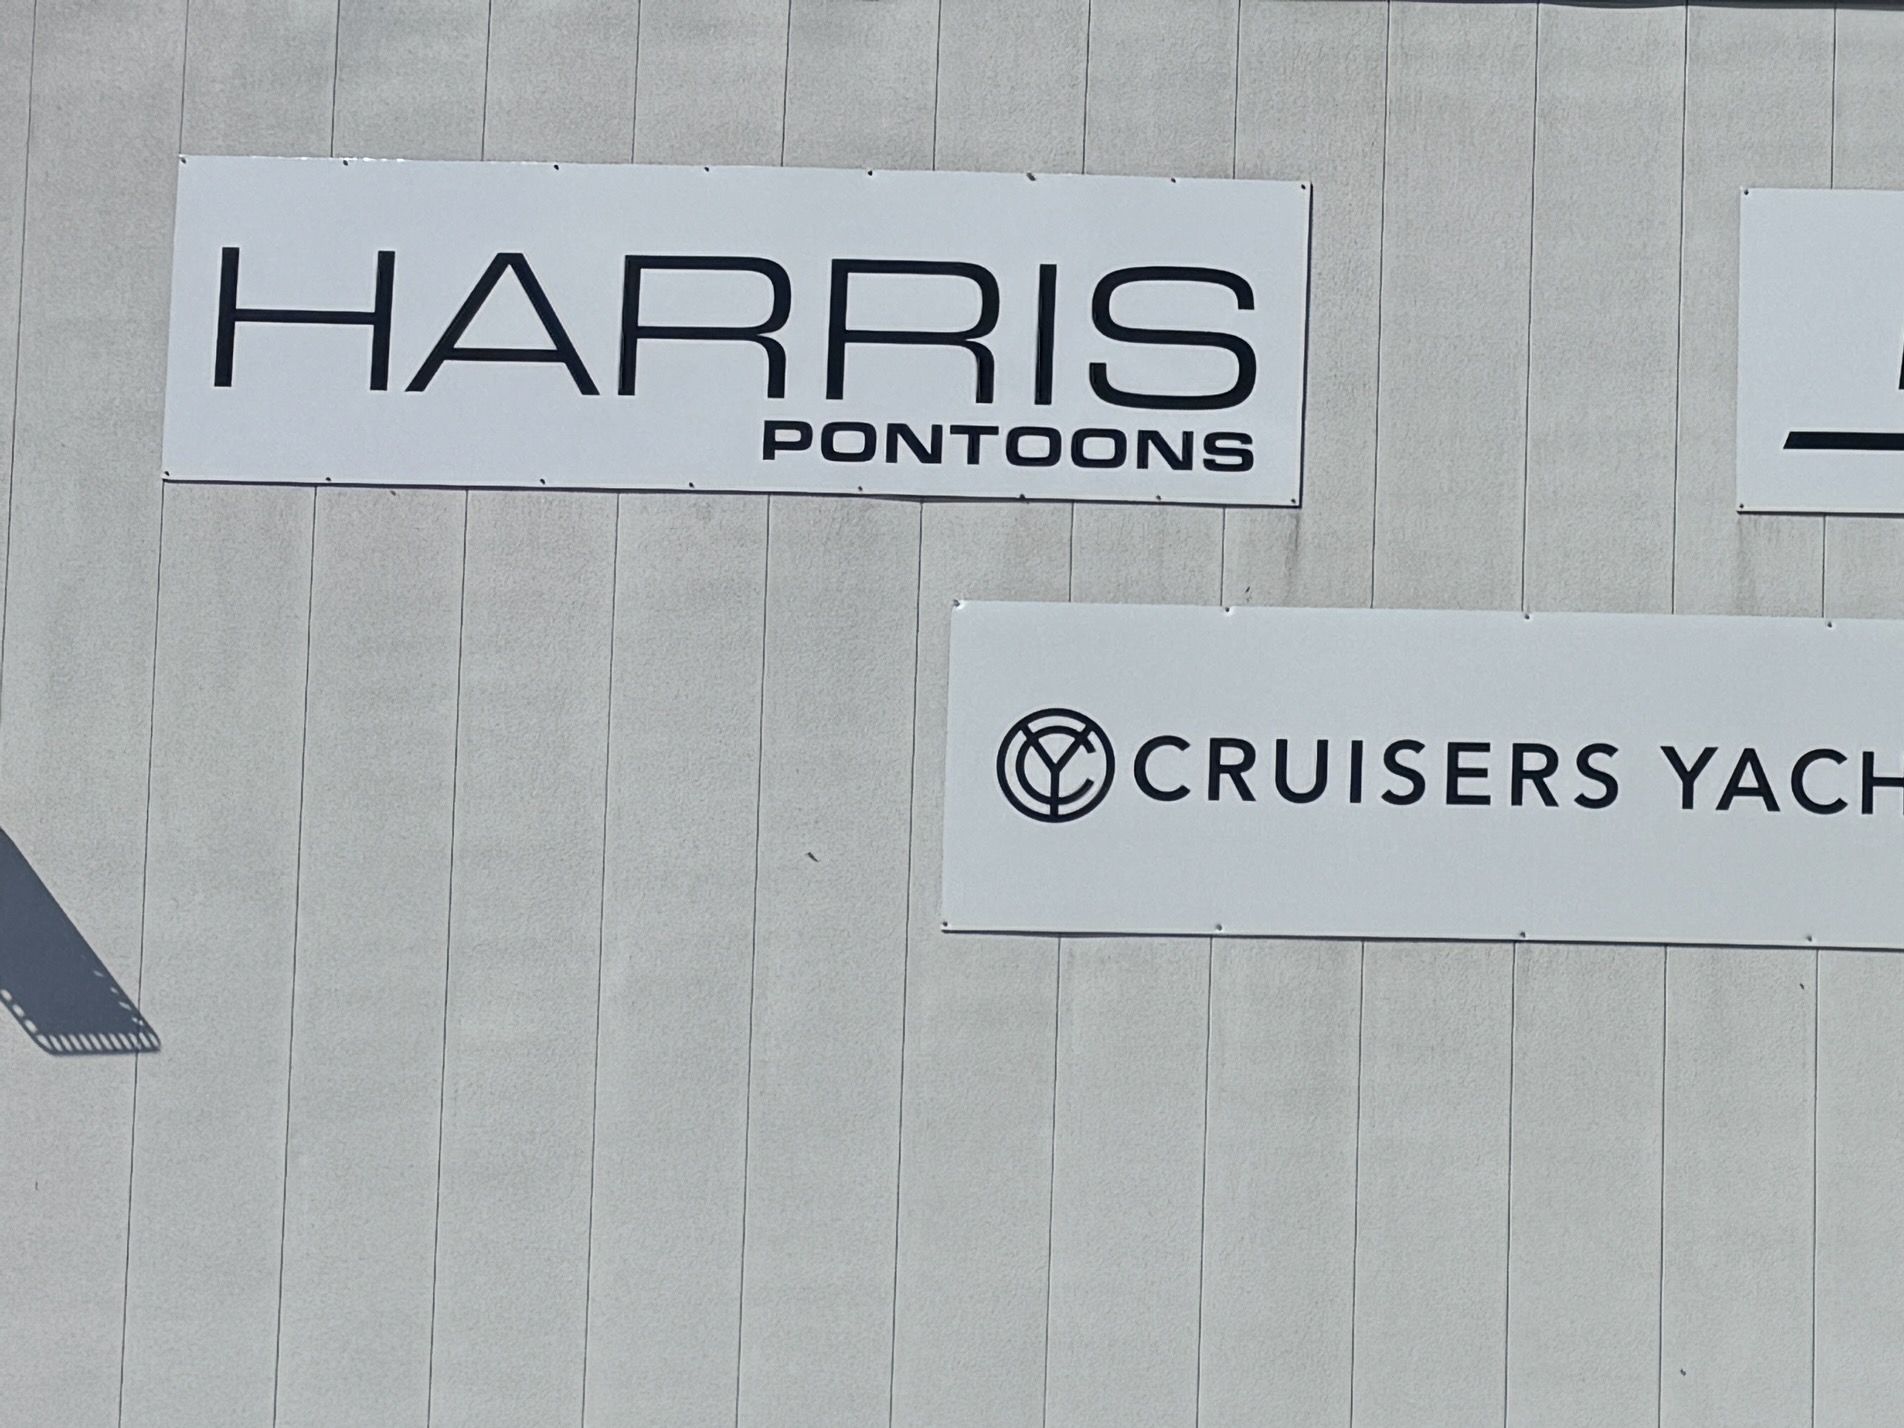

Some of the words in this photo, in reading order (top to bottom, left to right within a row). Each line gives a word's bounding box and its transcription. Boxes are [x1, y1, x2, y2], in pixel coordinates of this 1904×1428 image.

[214, 247, 1257, 410] HARRIS
[762, 420, 1254, 472] PONTOONS
[1133, 736, 1619, 809] CRUISERS
